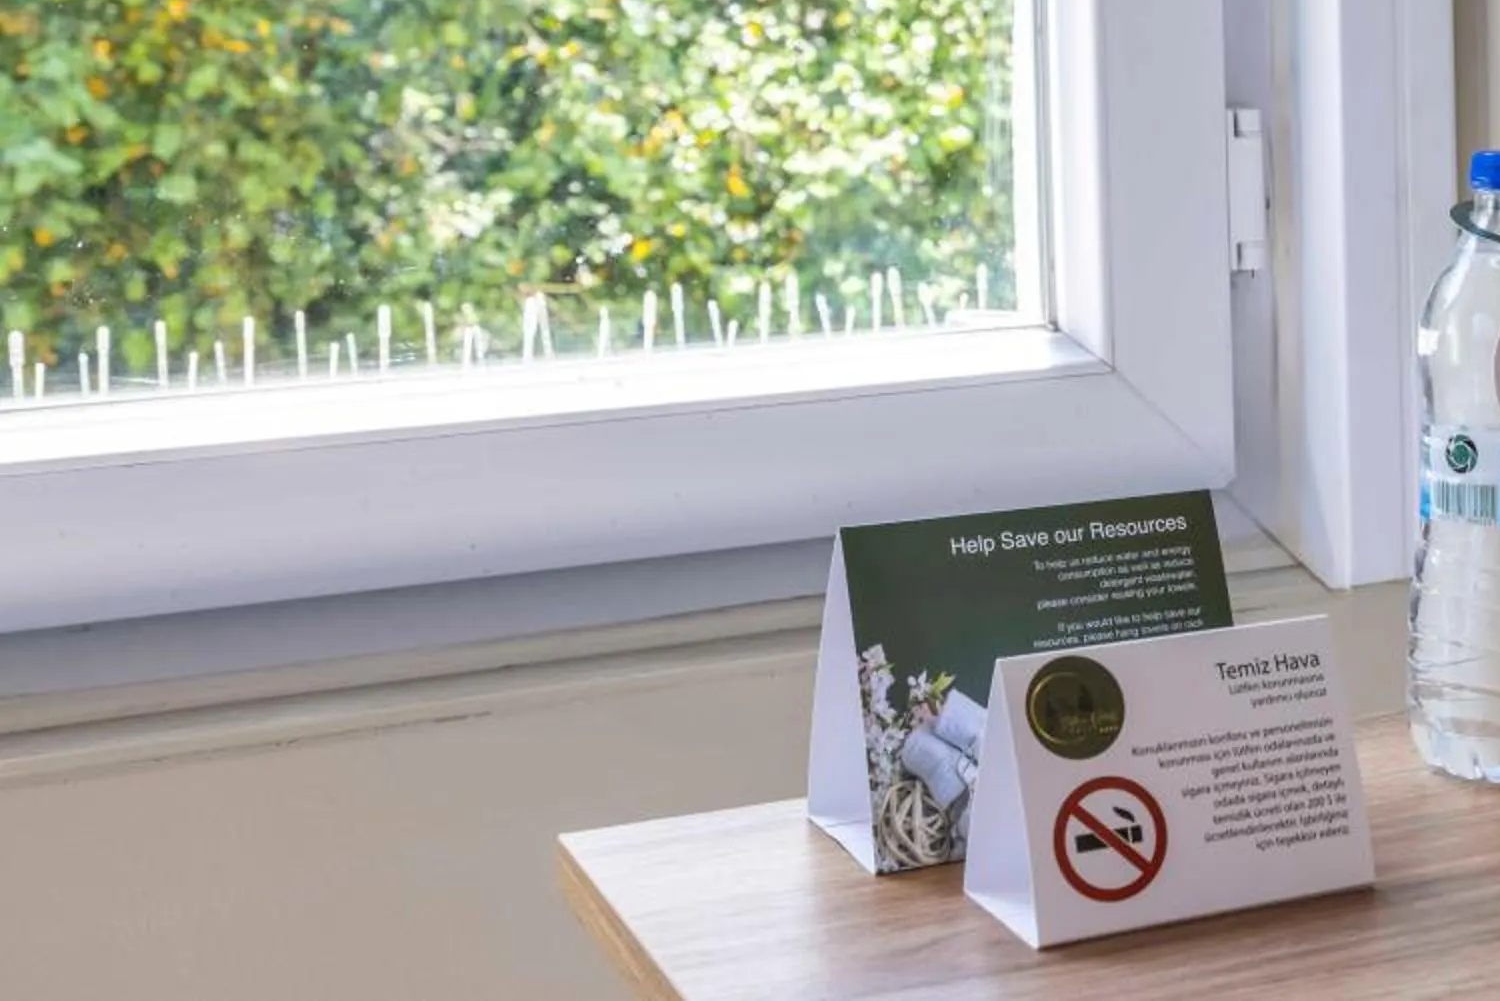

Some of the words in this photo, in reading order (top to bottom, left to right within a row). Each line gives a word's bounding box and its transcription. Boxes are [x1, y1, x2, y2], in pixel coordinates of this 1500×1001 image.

[950, 535, 995, 557] Help
[1001, 530, 1049, 550] Save
[1055, 526, 1084, 544] our
[1089, 516, 1188, 540] Resources
[1215, 657, 1271, 681] Temiz
[1273, 652, 1321, 672] Hava
